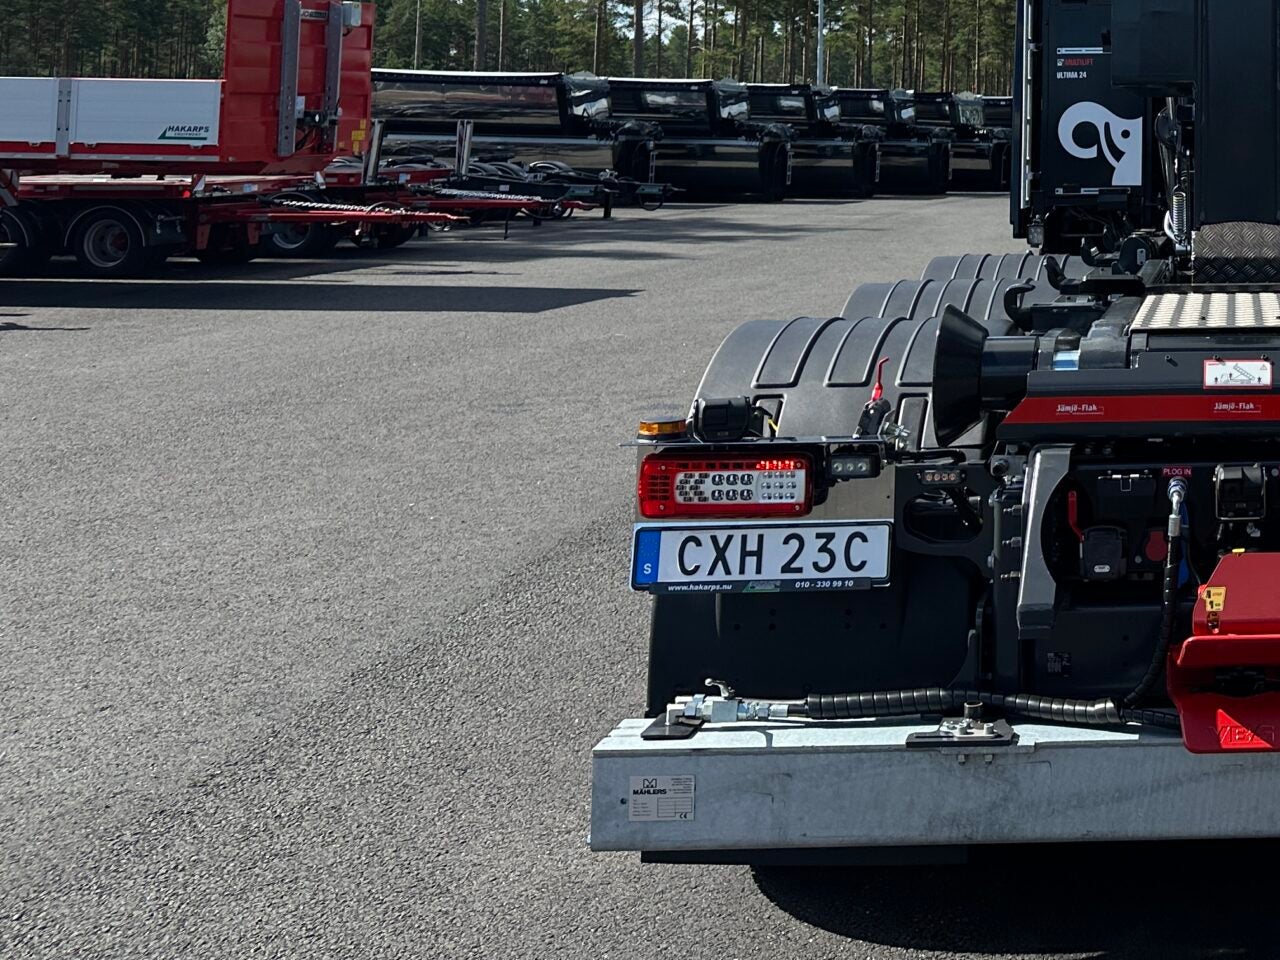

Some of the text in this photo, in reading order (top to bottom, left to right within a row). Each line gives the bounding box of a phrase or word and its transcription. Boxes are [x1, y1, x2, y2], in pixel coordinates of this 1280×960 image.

[1079, 71, 1087, 79] 24
[167, 125, 210, 133] HAKARPS
[677, 531, 869, 576] CXH 23C
[643, 563, 652, 575] S
[668, 584, 733, 592] www.hakarps.nu
